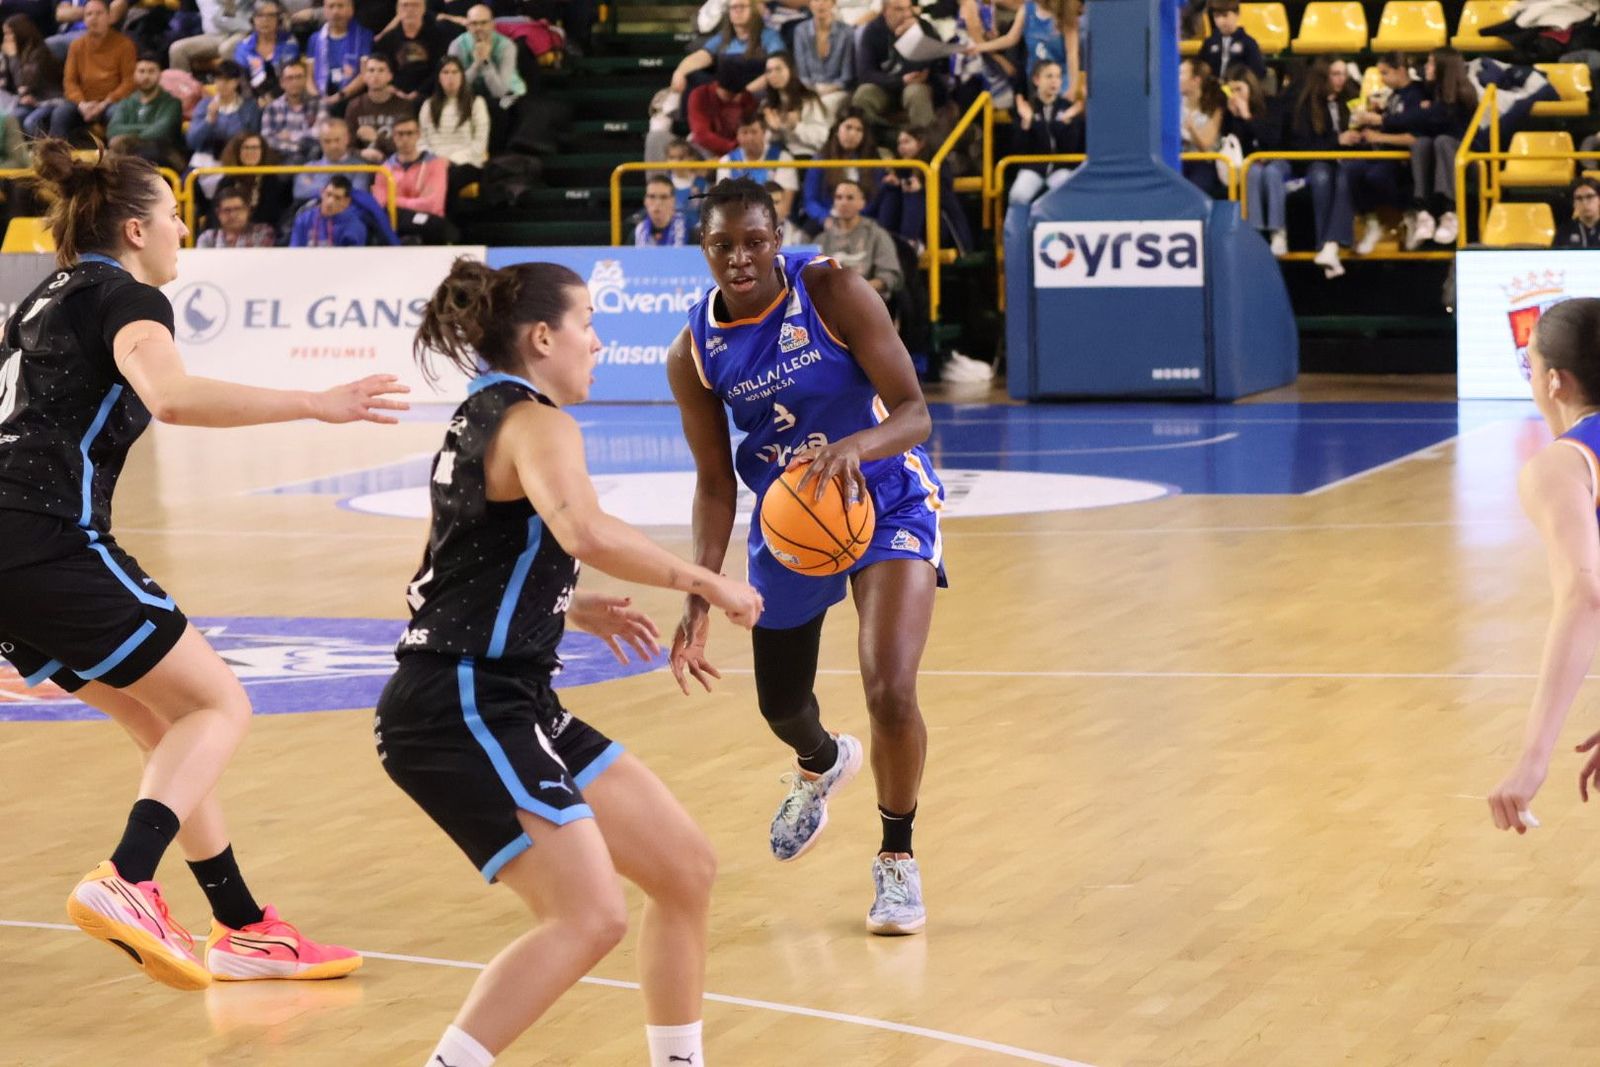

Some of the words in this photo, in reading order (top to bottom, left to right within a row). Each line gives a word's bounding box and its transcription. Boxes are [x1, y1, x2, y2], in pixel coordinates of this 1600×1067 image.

[243, 299, 291, 329] EL
[306, 295, 431, 330] GANS
[289, 346, 377, 359] PERFUMES
[782, 349, 822, 375] LEÓN
[773, 402, 796, 432] 3
